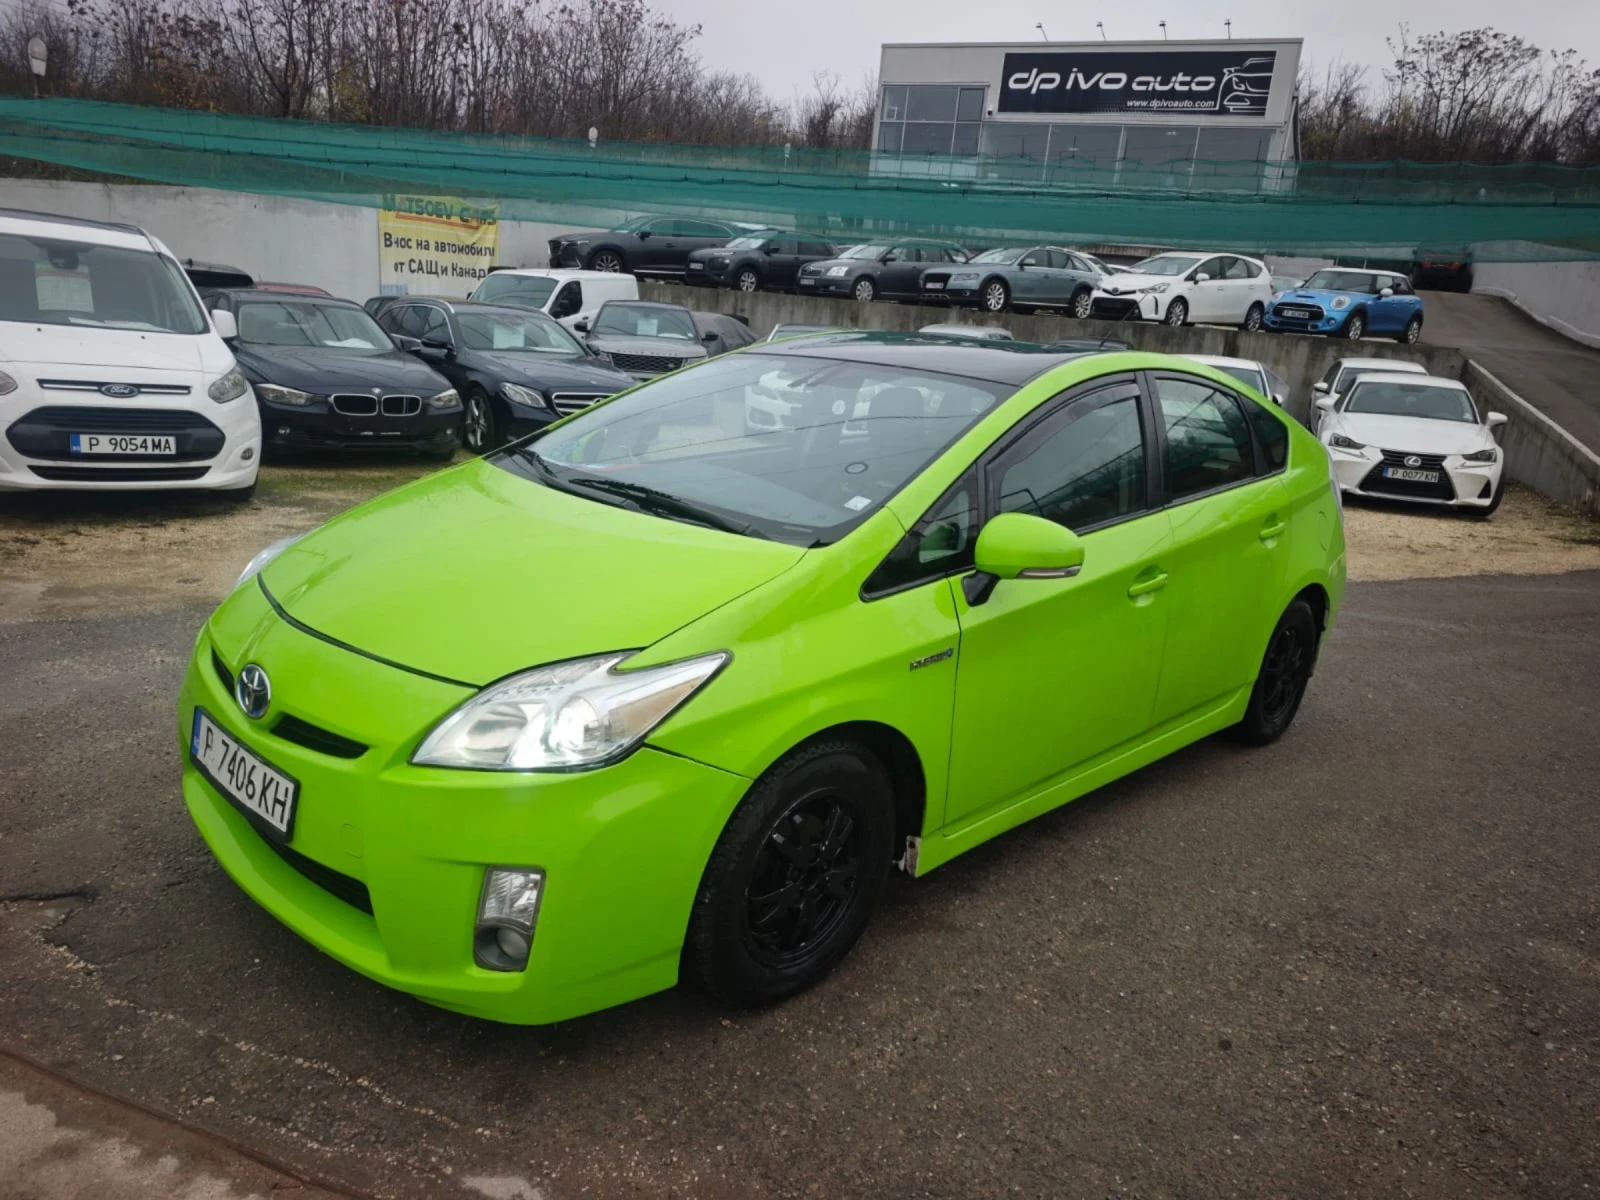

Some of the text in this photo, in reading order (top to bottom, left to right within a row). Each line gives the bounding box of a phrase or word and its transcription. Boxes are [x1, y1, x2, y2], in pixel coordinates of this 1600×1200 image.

[1008, 68, 1216, 94] dp ivo auto
[1126, 99, 1215, 109] www.dpivoauto.com
[383, 232, 412, 249] Внос
[416, 239, 430, 251] на
[393, 261, 406, 273] от
[451, 262, 487, 281] Канад
[89, 436, 99, 451] P
